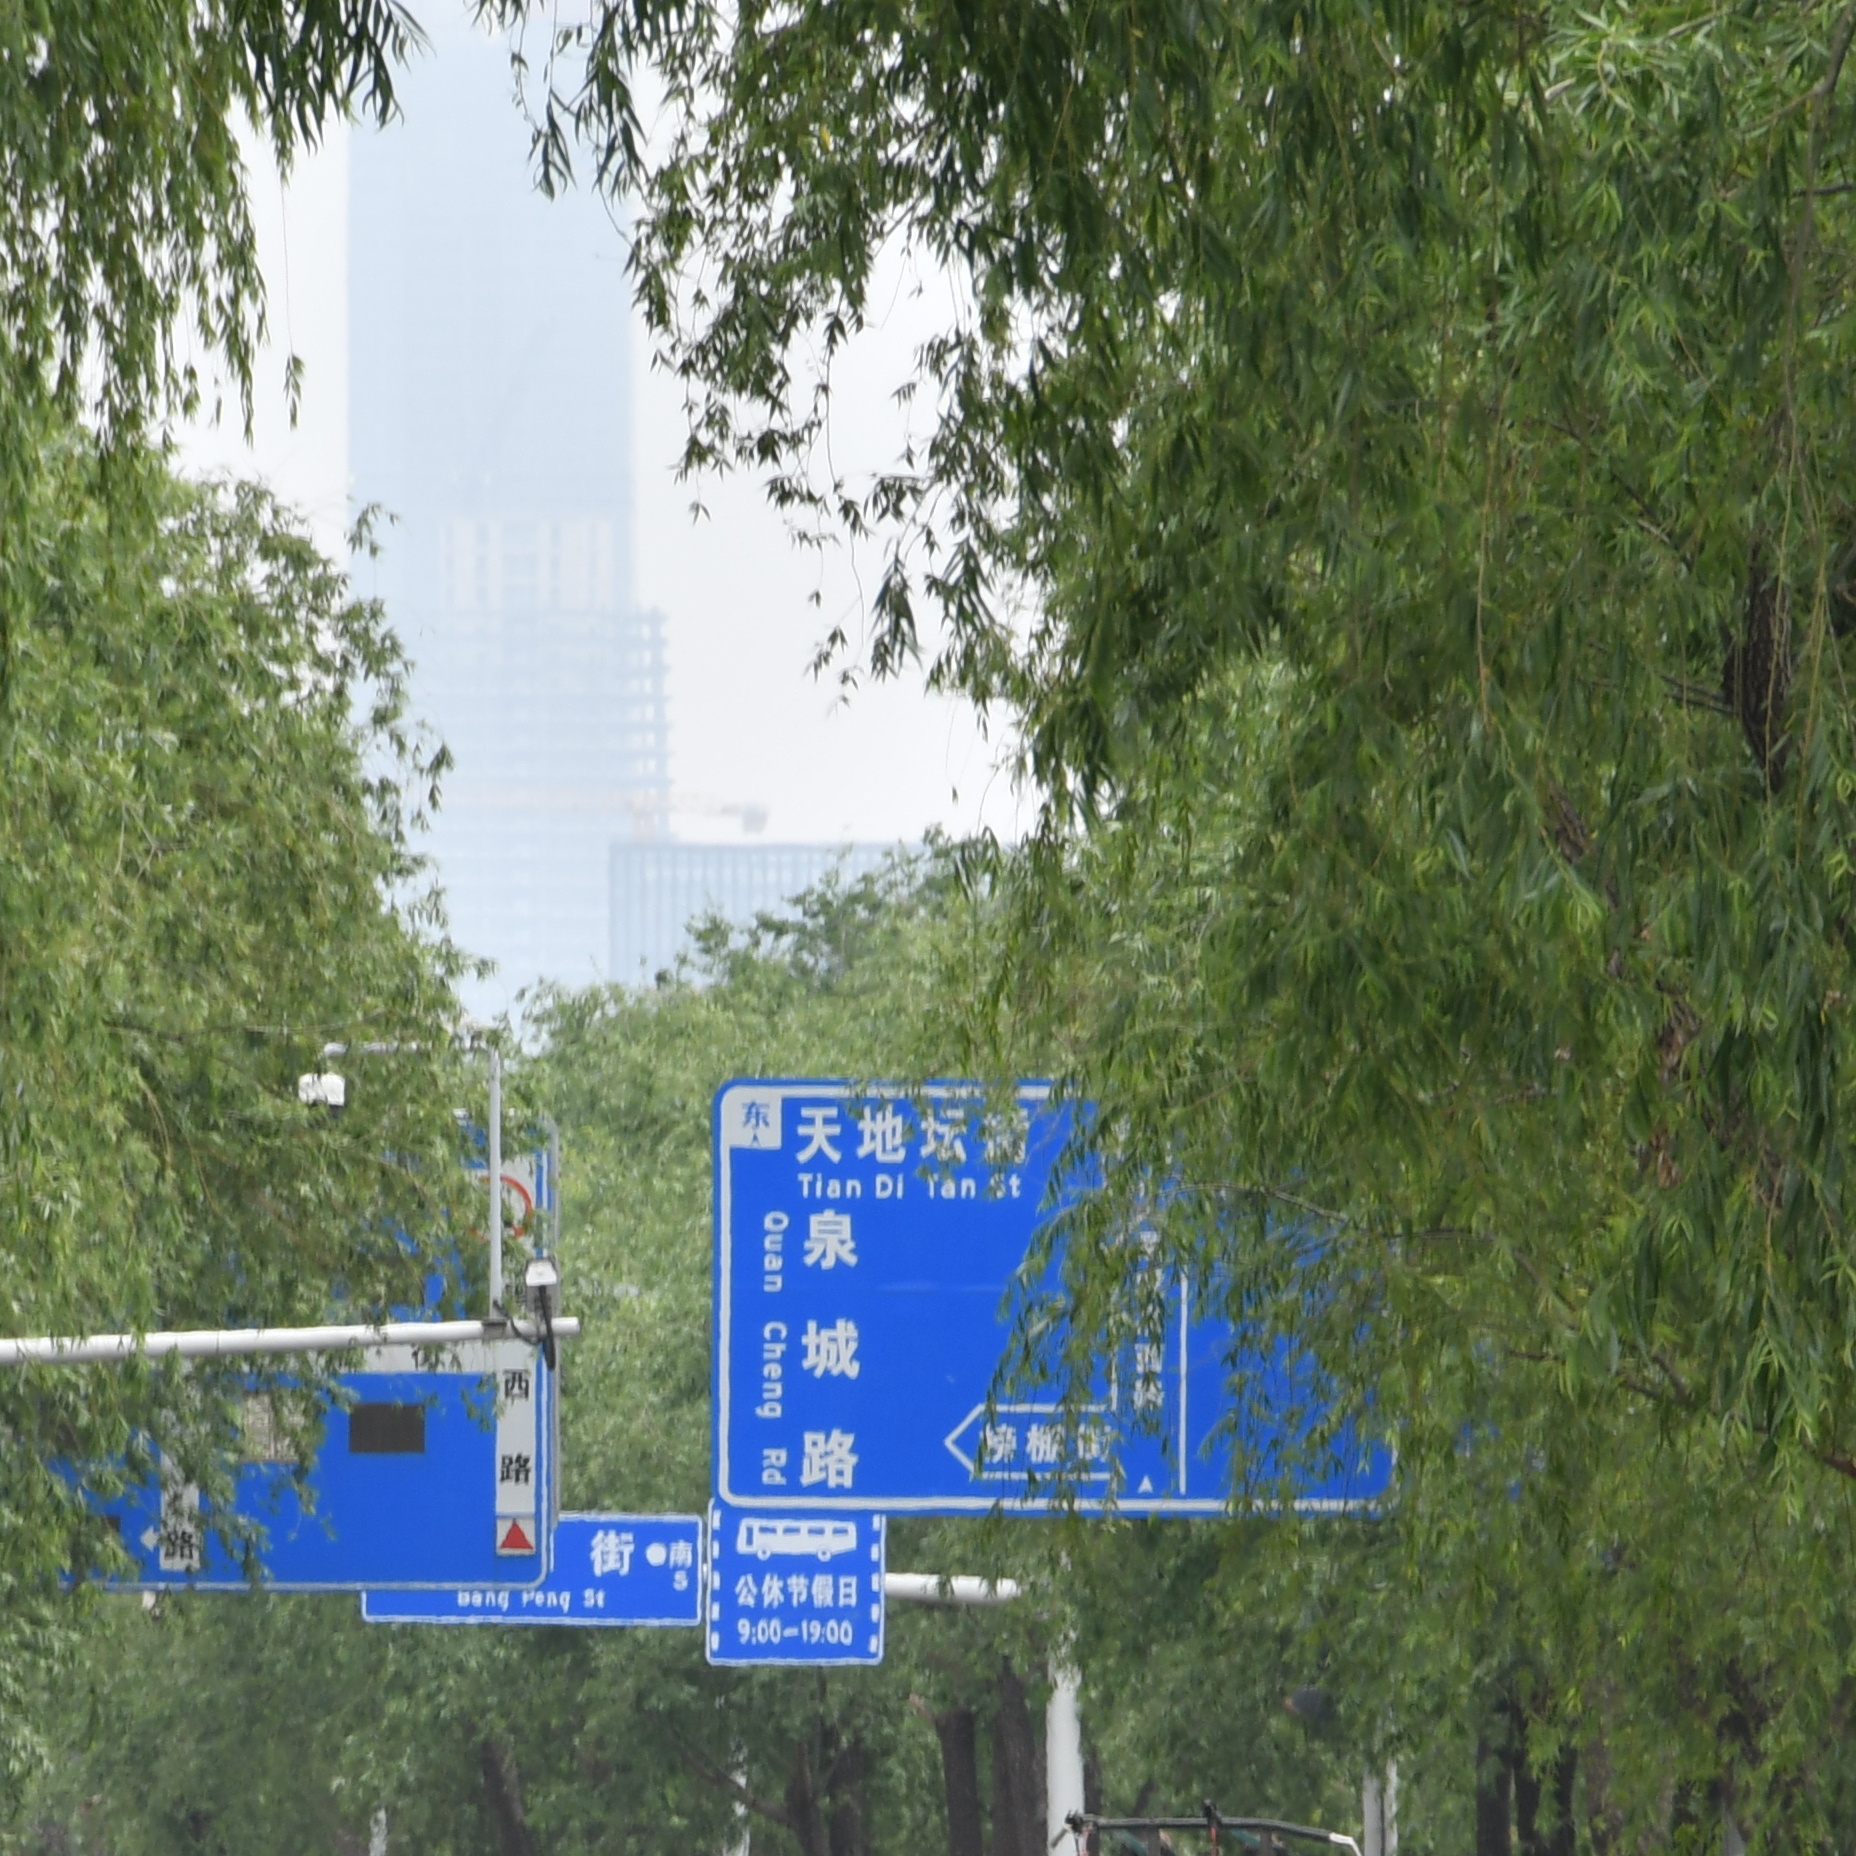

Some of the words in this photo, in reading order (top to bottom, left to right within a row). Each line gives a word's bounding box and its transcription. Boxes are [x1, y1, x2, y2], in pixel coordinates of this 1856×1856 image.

[742, 1101, 770, 1127] 东
[797, 1171, 862, 1199] Tian
[874, 1171, 905, 1199] Di
[762, 1211, 789, 1293] Quan
[800, 1209, 860, 1489] 泉城路
[755, 1321, 788, 1420] Cheng
[761, 1448, 787, 1486] Rd
[734, 1573, 858, 1609] 公休节假日
